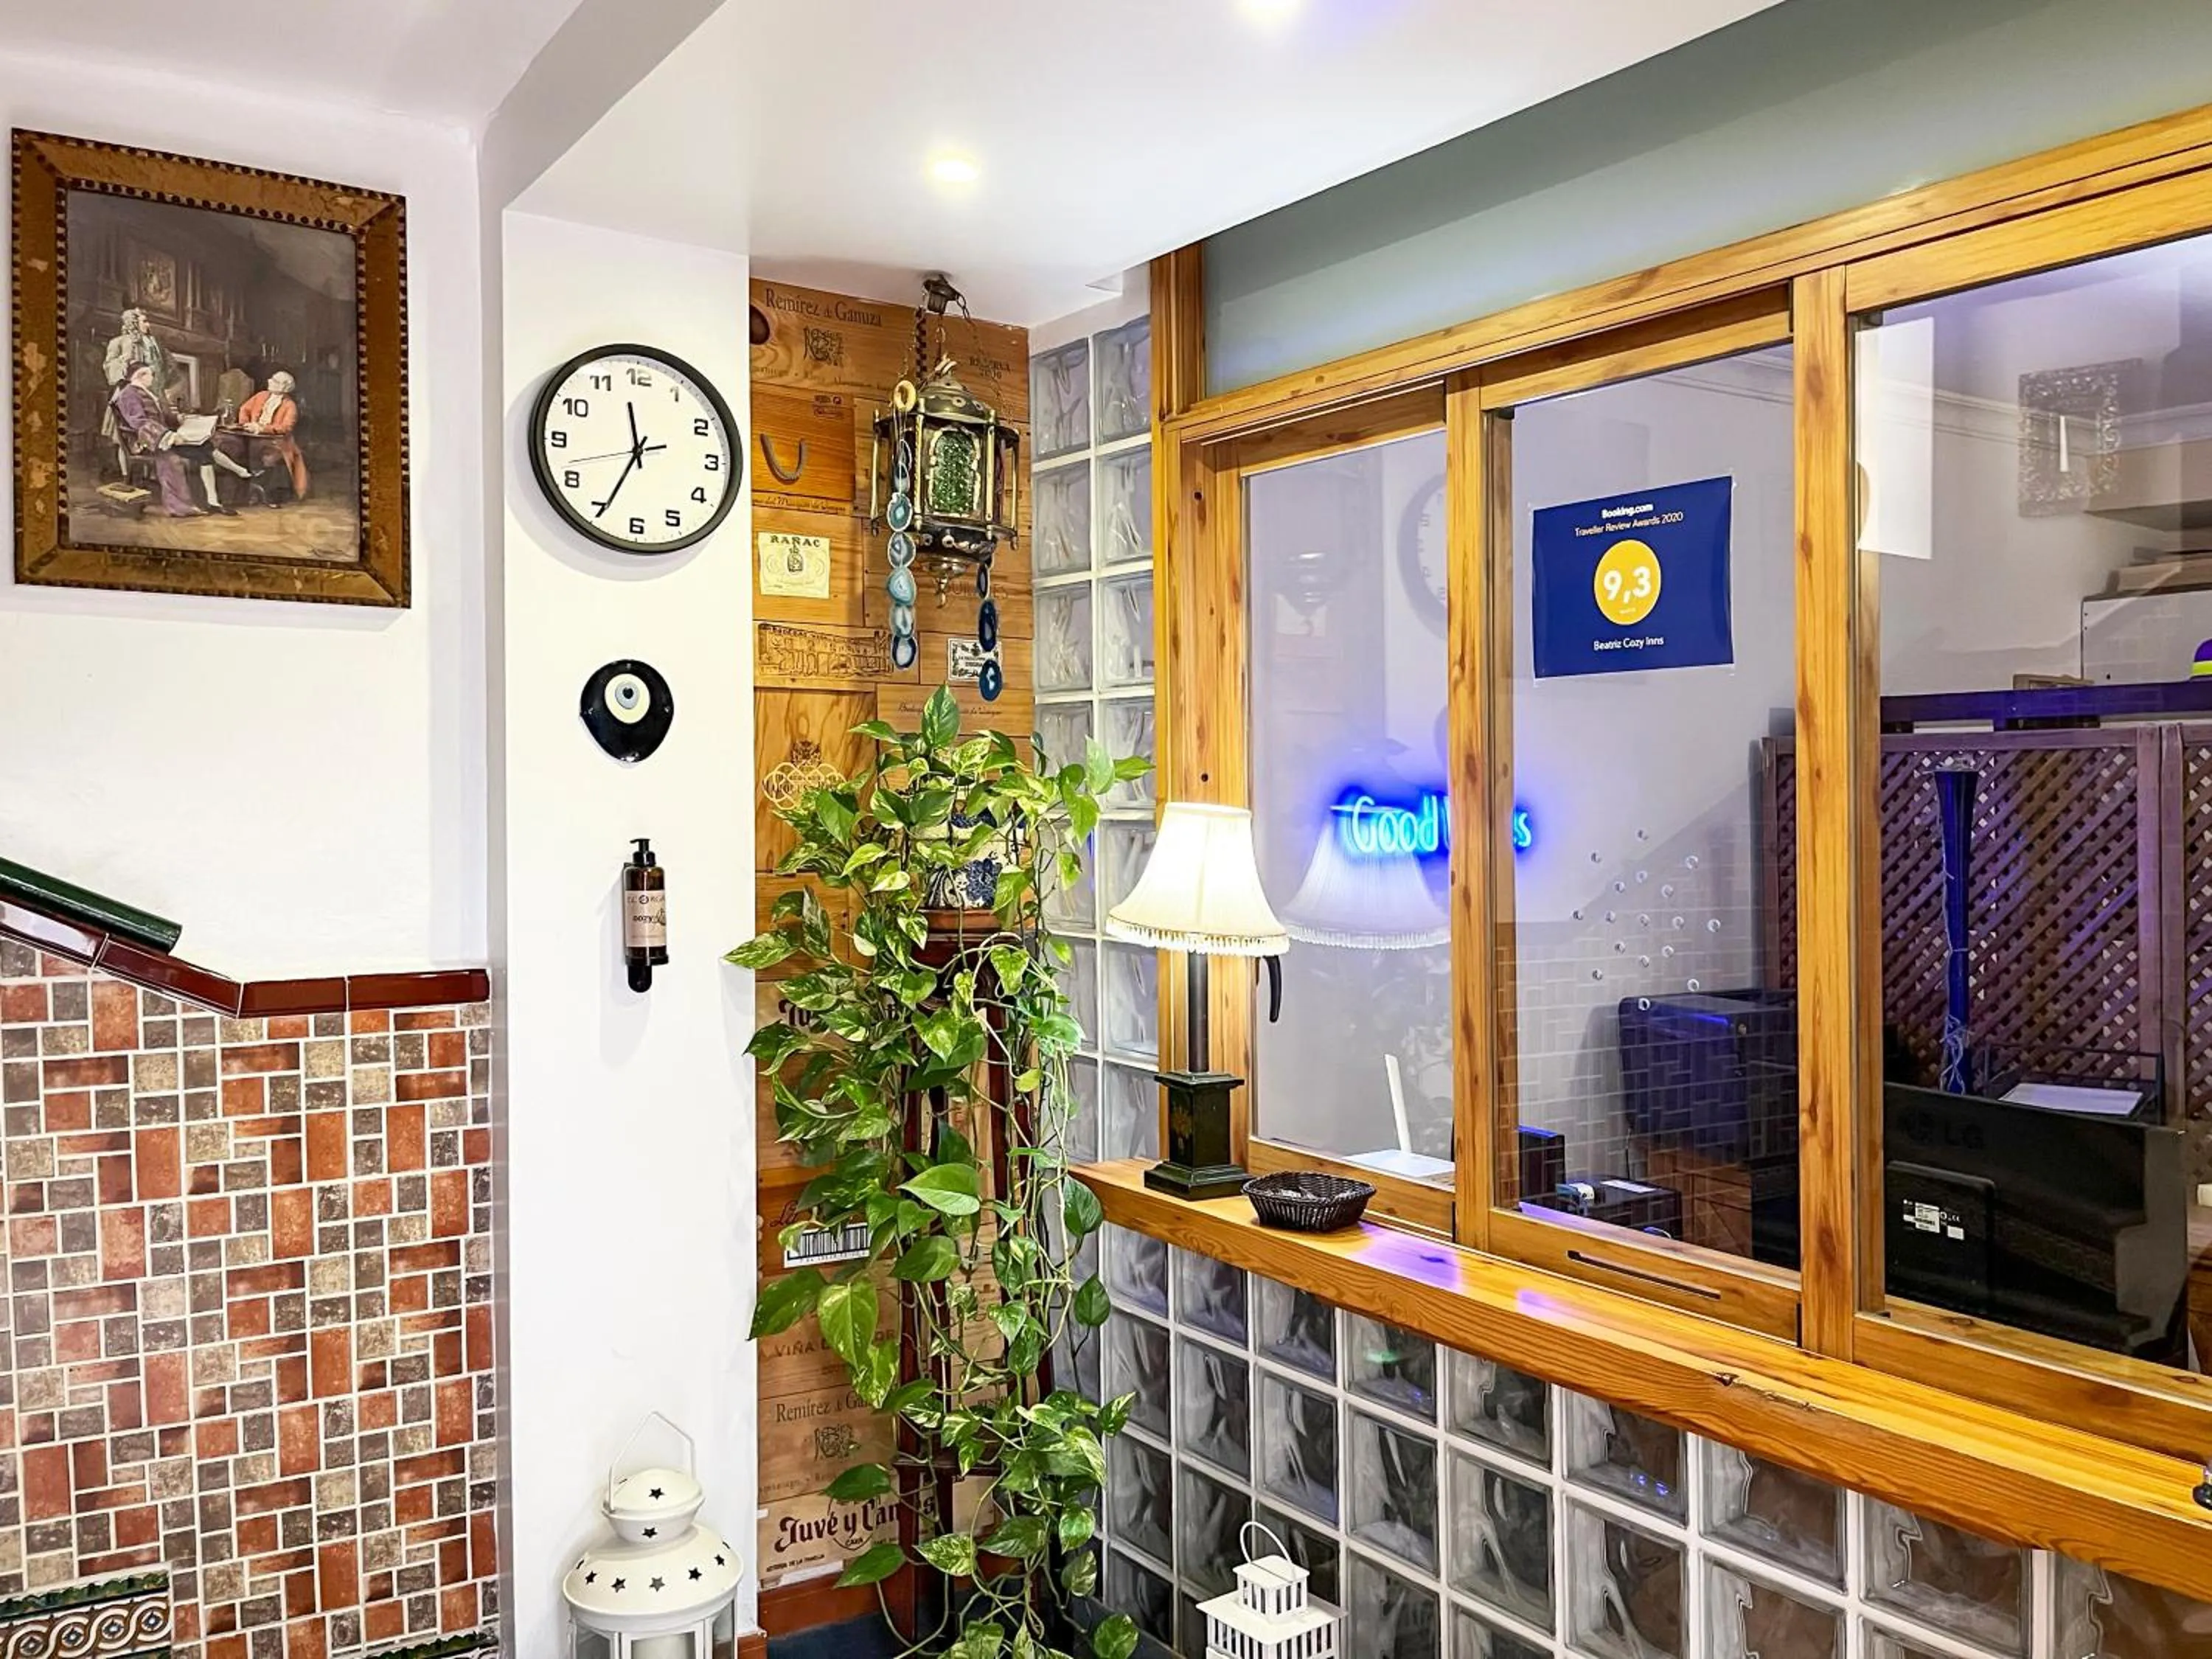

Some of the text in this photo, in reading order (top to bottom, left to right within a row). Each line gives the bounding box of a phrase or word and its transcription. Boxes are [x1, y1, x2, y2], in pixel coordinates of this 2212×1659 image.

[590, 375, 611, 392] 11
[626, 368, 652, 387] 12
[670, 386, 679, 403] 1
[563, 397, 588, 418] 10
[694, 418, 709, 437] 2
[551, 431, 567, 448] 9
[704, 453, 719, 471] 3
[564, 470, 580, 488] 8
[691, 487, 706, 504] 4
[591, 501, 607, 518] 7
[665, 509, 681, 527] 5
[1601, 504, 1654, 519] Booking.com
[630, 518, 644, 535] 6
[1605, 520, 1631, 532] Review
[1632, 515, 1660, 528] Awards
[1661, 512, 1683, 524] 2020
[1604, 566, 1652, 604] 9,3
[1593, 636, 1663, 651] Beatriz Cozy Inns
[1352, 796, 1437, 852] Good
[1944, 1119, 1985, 1149] LG
[774, 1512, 838, 1552] Juvé
[844, 1512, 857, 1539] y
